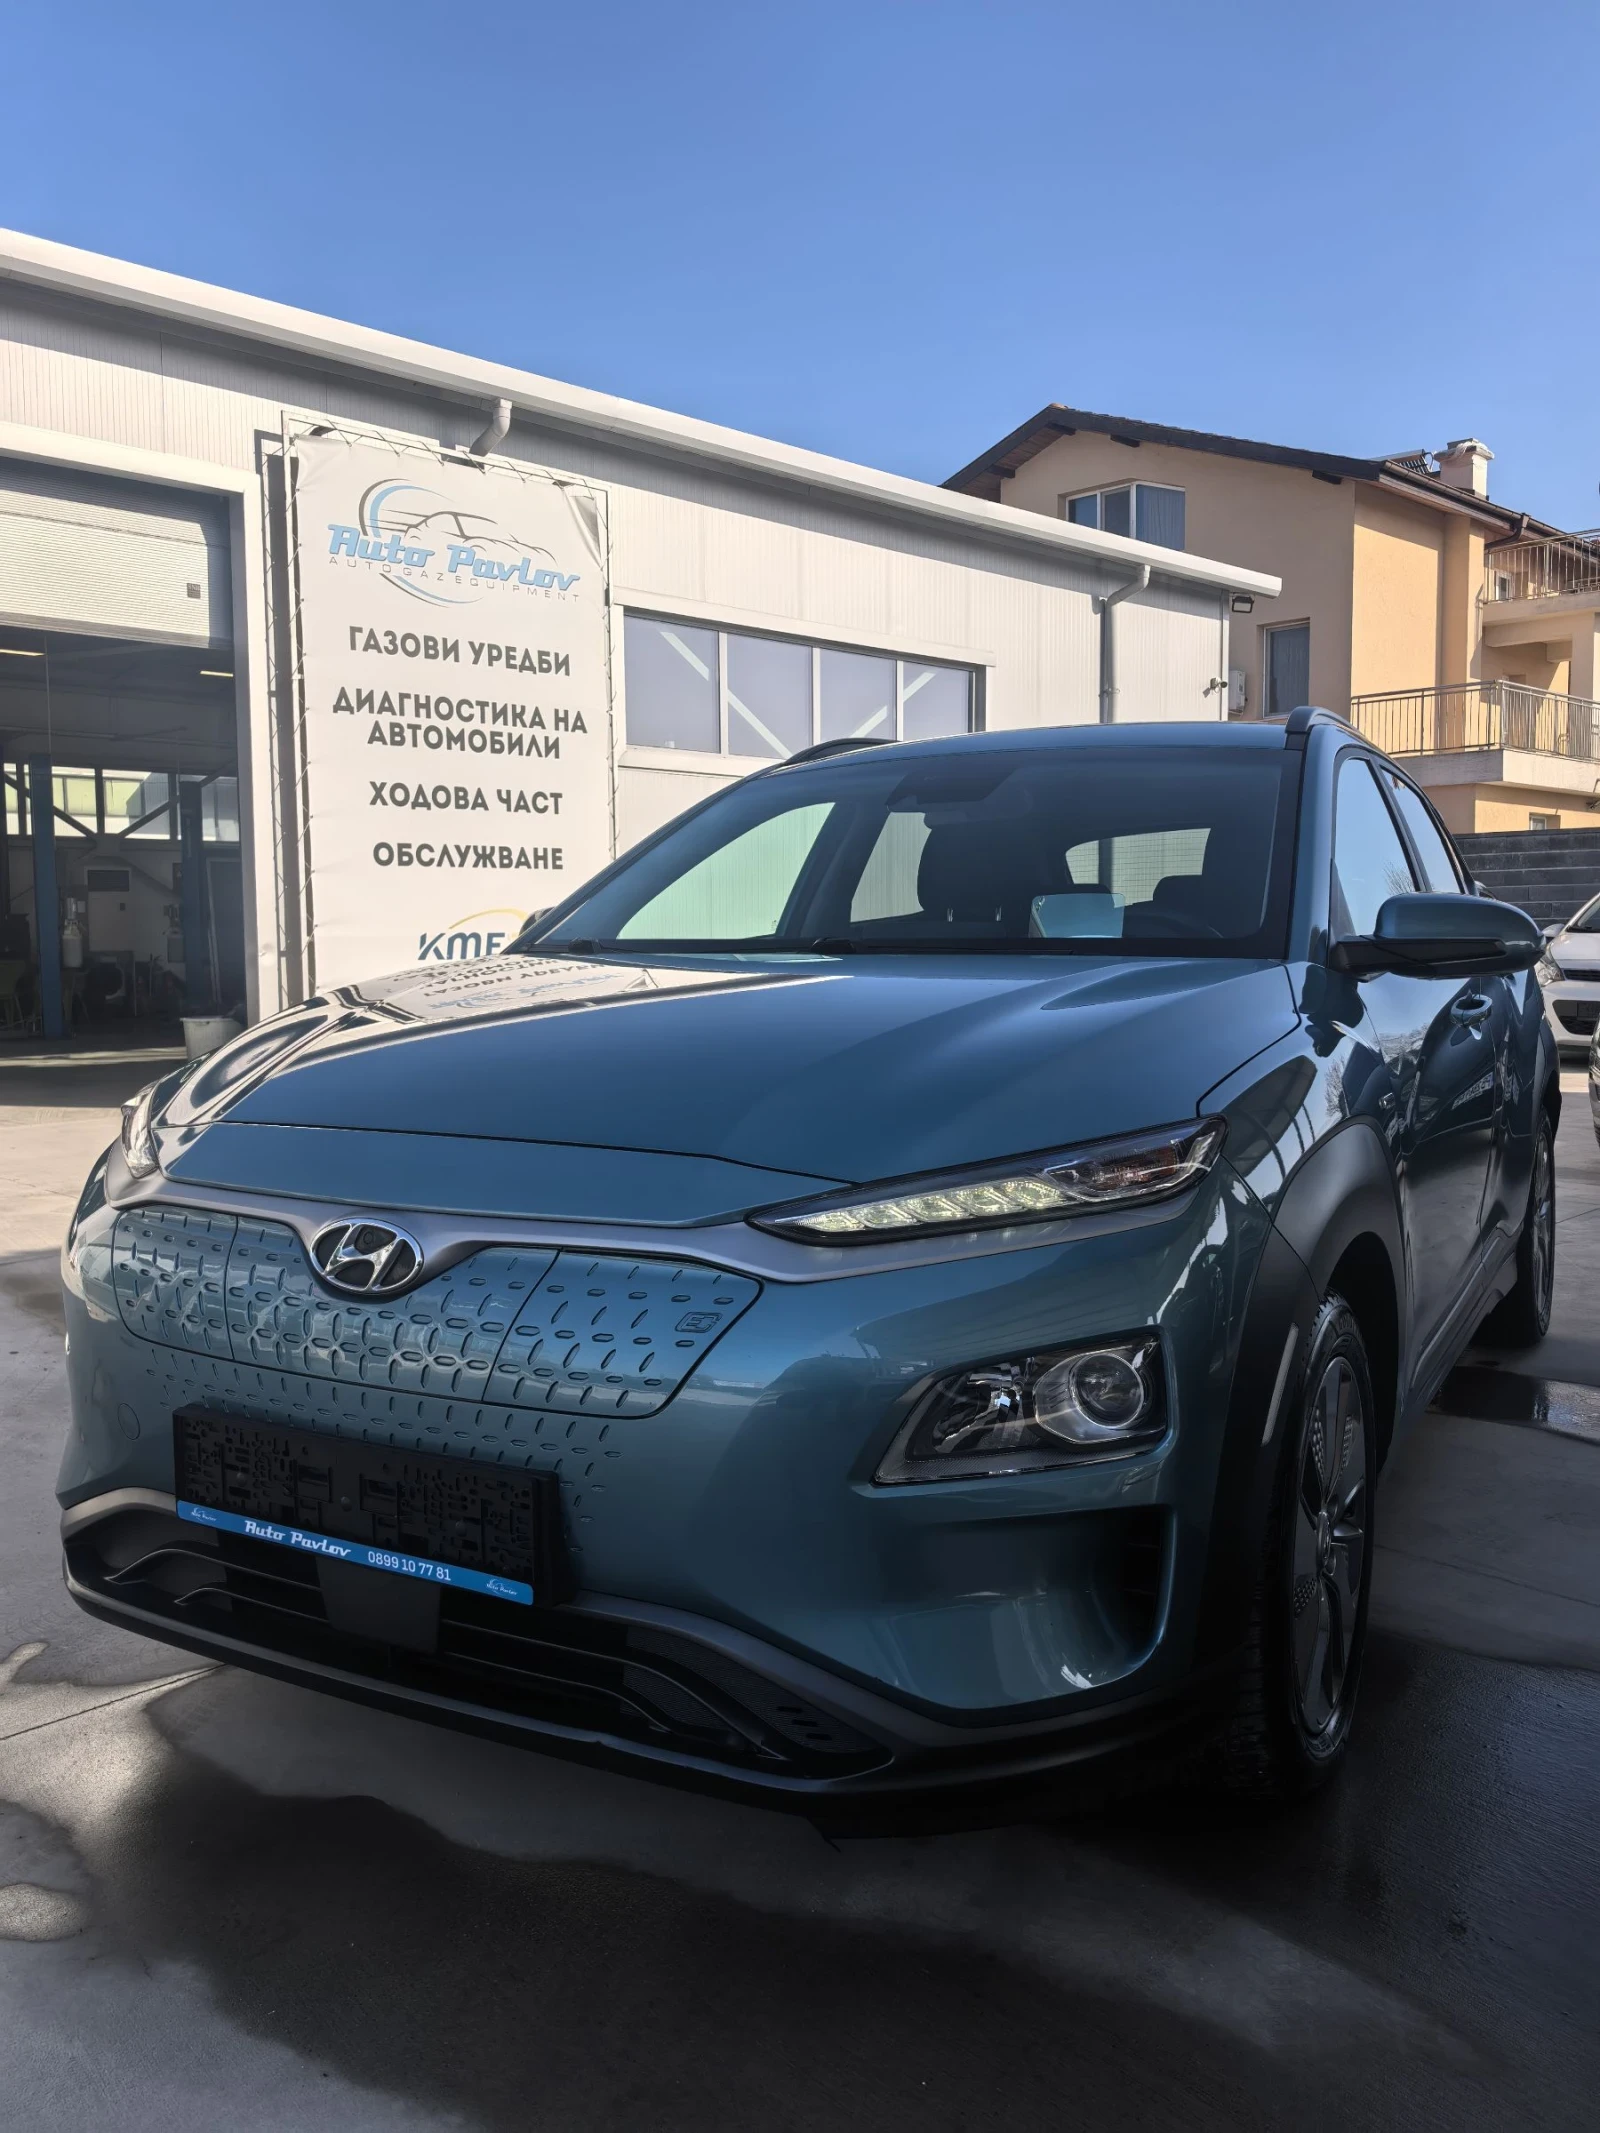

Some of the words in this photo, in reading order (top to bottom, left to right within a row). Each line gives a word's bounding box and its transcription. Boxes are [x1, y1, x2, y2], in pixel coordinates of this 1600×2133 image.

[328, 524, 436, 567] Auto
[349, 625, 460, 663] ГАЗОВИ
[467, 640, 571, 677] УРЕДБИ
[332, 686, 547, 730] ДИАГНОСТИКА
[554, 708, 588, 734] НА
[367, 720, 560, 760] АВТОМОБИЛИ
[369, 780, 490, 812] ХОДОВА
[496, 788, 563, 815] ЧАСТ
[372, 841, 564, 870] ОБСЛУЖВАНЕ
[244, 1520, 286, 1541] Auto
[290, 1531, 351, 1557] Pavlov
[368, 1551, 399, 1569] 0899
[401, 1558, 416, 1573] 10
[418, 1562, 434, 1576] 77
[436, 1566, 451, 1581] 81
